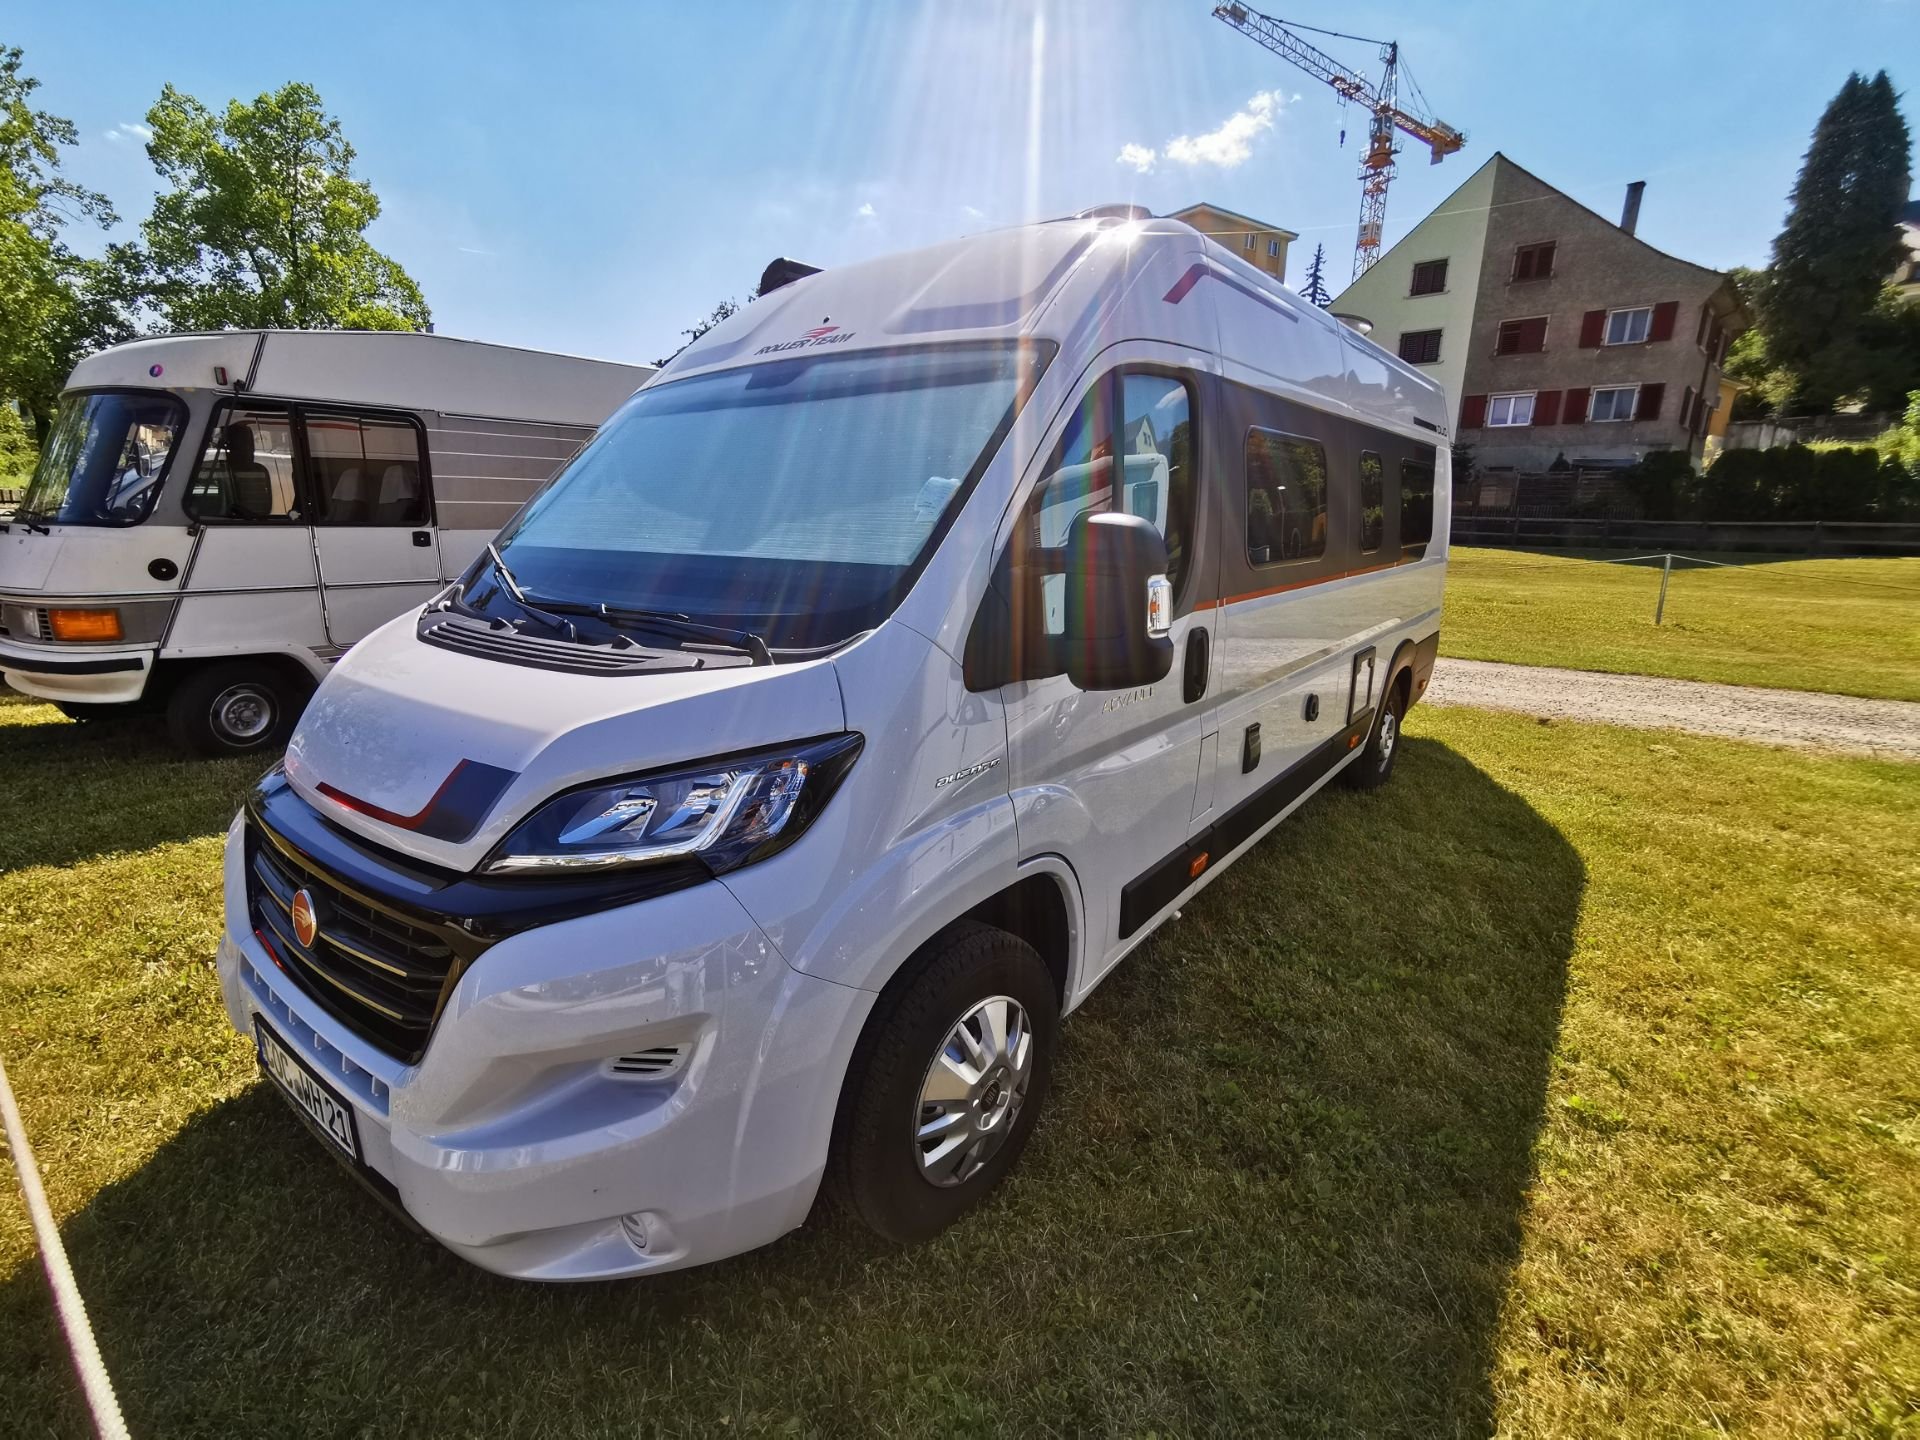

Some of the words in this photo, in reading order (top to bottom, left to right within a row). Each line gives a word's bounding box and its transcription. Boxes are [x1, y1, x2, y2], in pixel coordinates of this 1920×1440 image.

[754, 339, 811, 355] ROLLER
[809, 332, 856, 346] TEAM
[325, 1101, 353, 1149] 21
